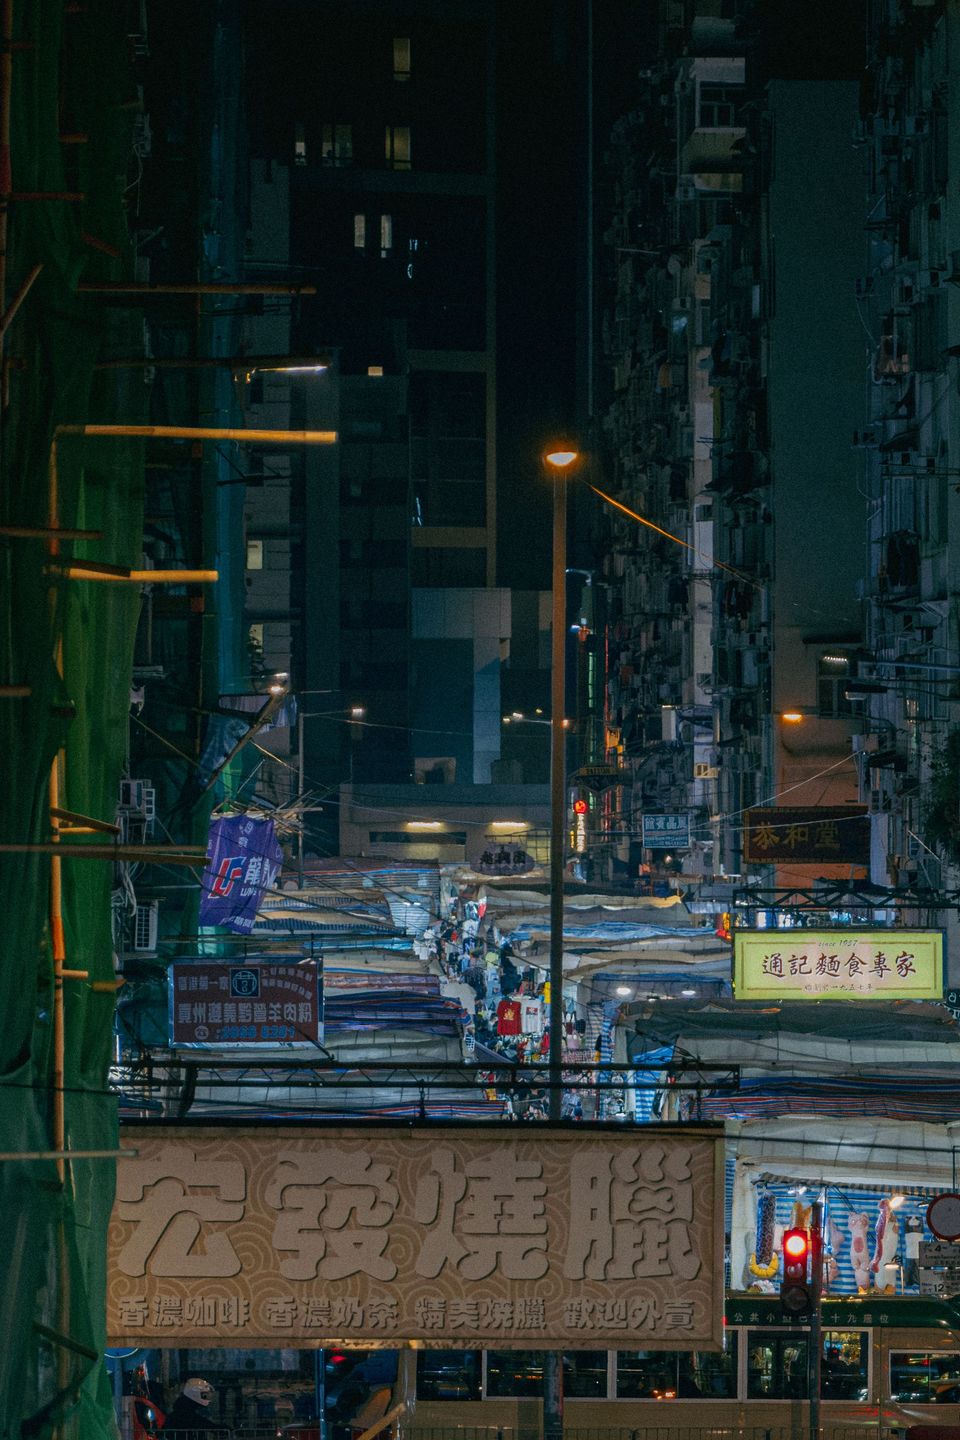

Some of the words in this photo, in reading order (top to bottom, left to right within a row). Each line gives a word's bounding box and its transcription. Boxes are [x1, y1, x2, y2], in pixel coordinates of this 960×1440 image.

[762, 951, 917, 978] 通記麵食專家
[118, 1295, 251, 1328] 香濃咖啡
[266, 1295, 399, 1328] 香濃奶茶
[562, 1295, 697, 1331] 歡迎外賣
